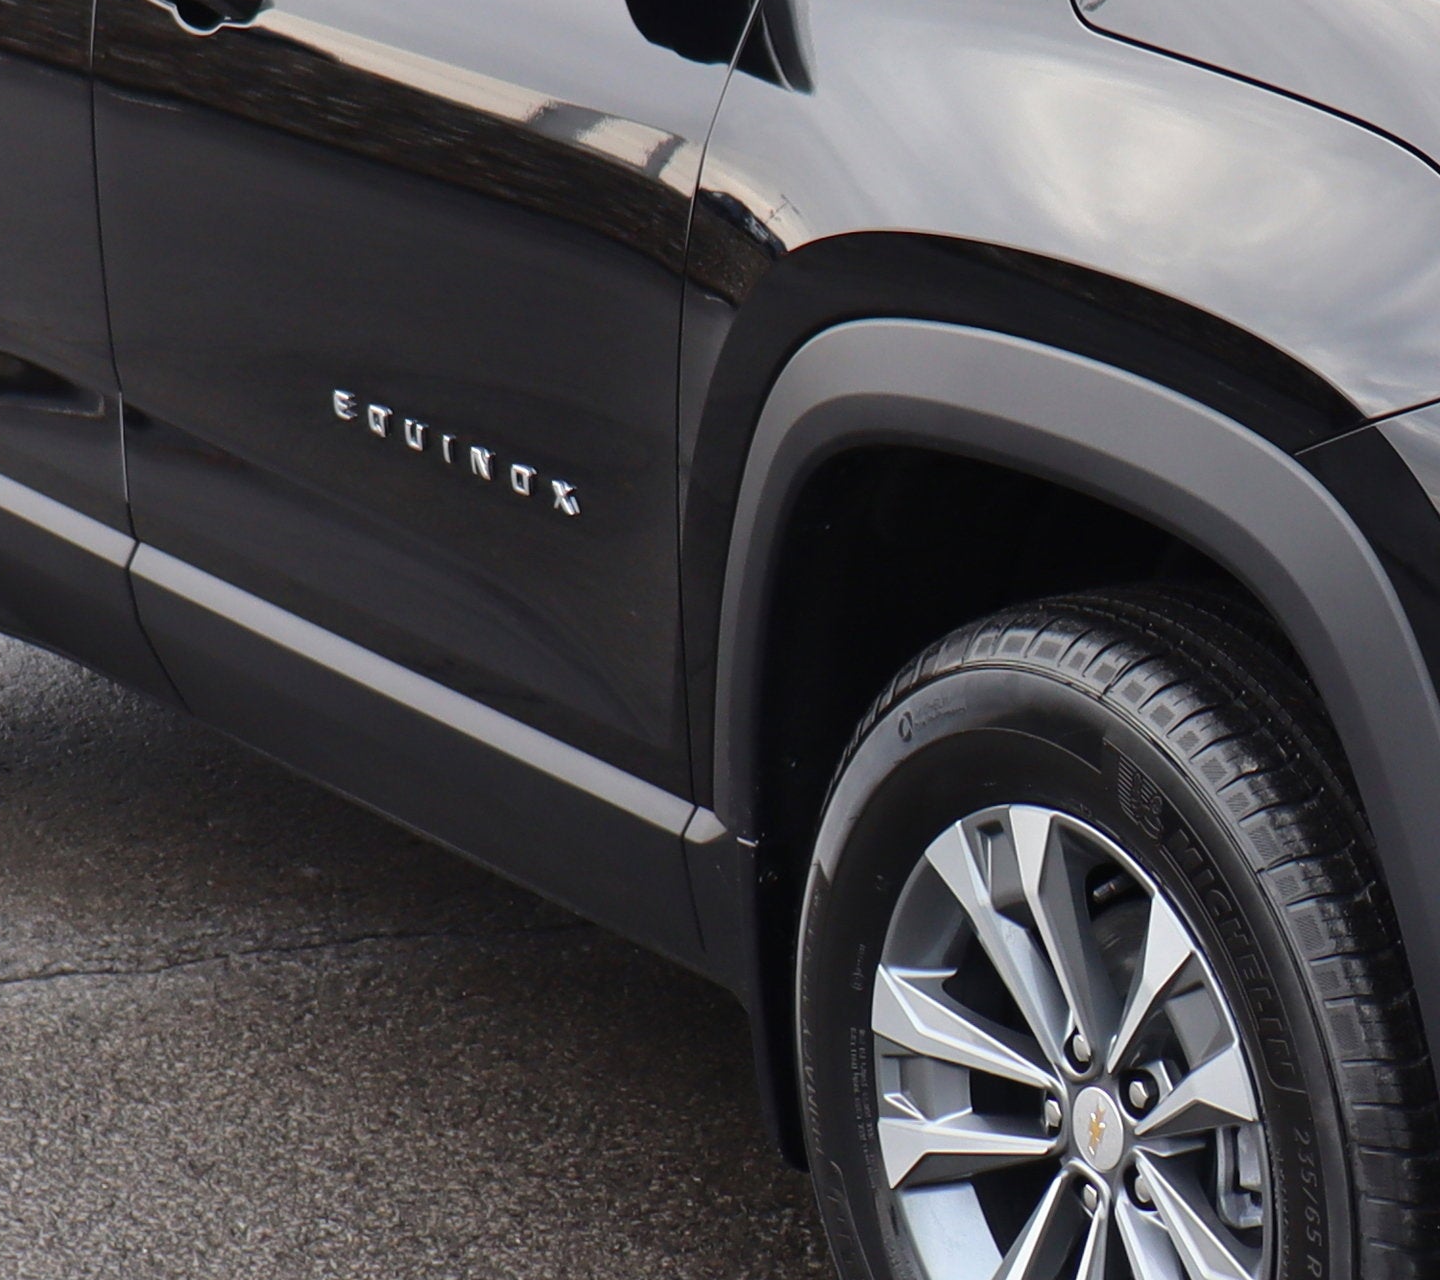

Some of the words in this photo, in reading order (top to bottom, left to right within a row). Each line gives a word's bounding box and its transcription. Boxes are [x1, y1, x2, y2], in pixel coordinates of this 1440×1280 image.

[332, 388, 582, 517] EQUINOX
[1160, 823, 1298, 1090] MICHELIN
[1293, 1126, 1323, 1249] 235/65
[1306, 1252, 1324, 1280] R
